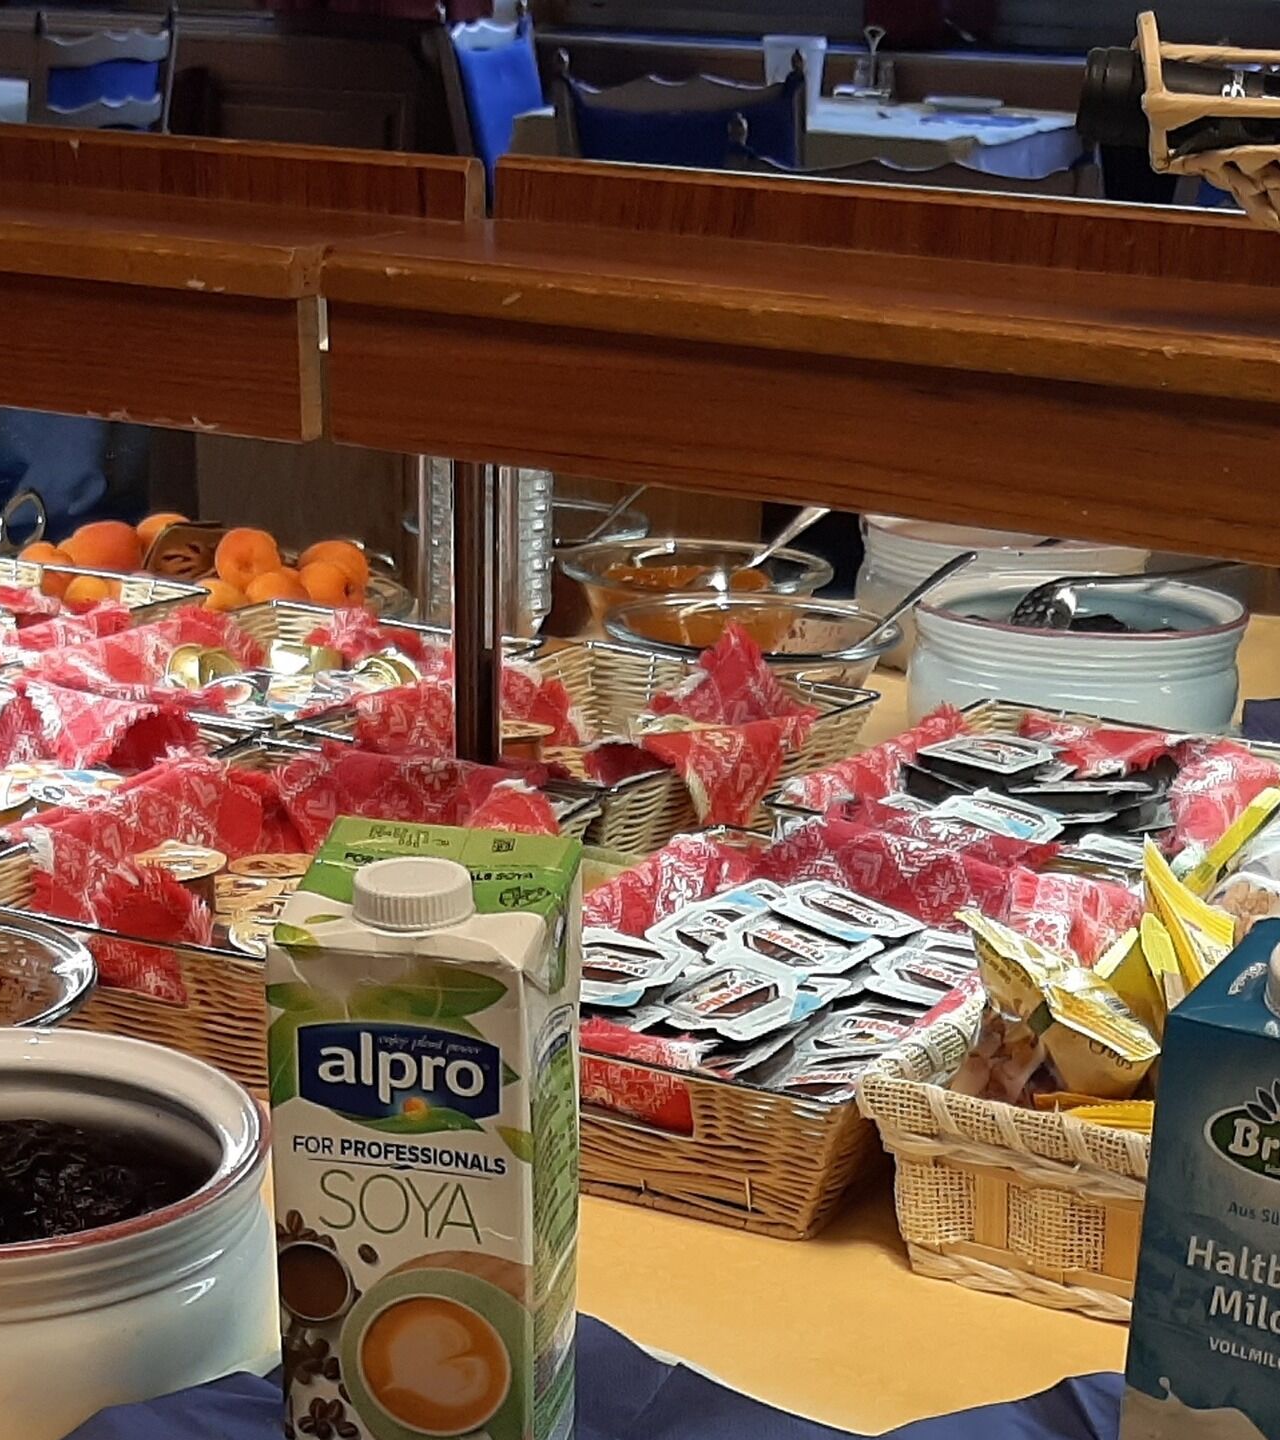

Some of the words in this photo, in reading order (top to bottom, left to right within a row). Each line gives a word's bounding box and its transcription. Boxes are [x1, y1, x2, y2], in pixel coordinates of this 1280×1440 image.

[317, 1031, 485, 1104] alpro
[292, 1134, 334, 1155] FOR
[340, 1138, 507, 1175] PROFESSIONALS
[318, 1168, 483, 1245] SOYA
[1228, 1200, 1256, 1220] Aus
